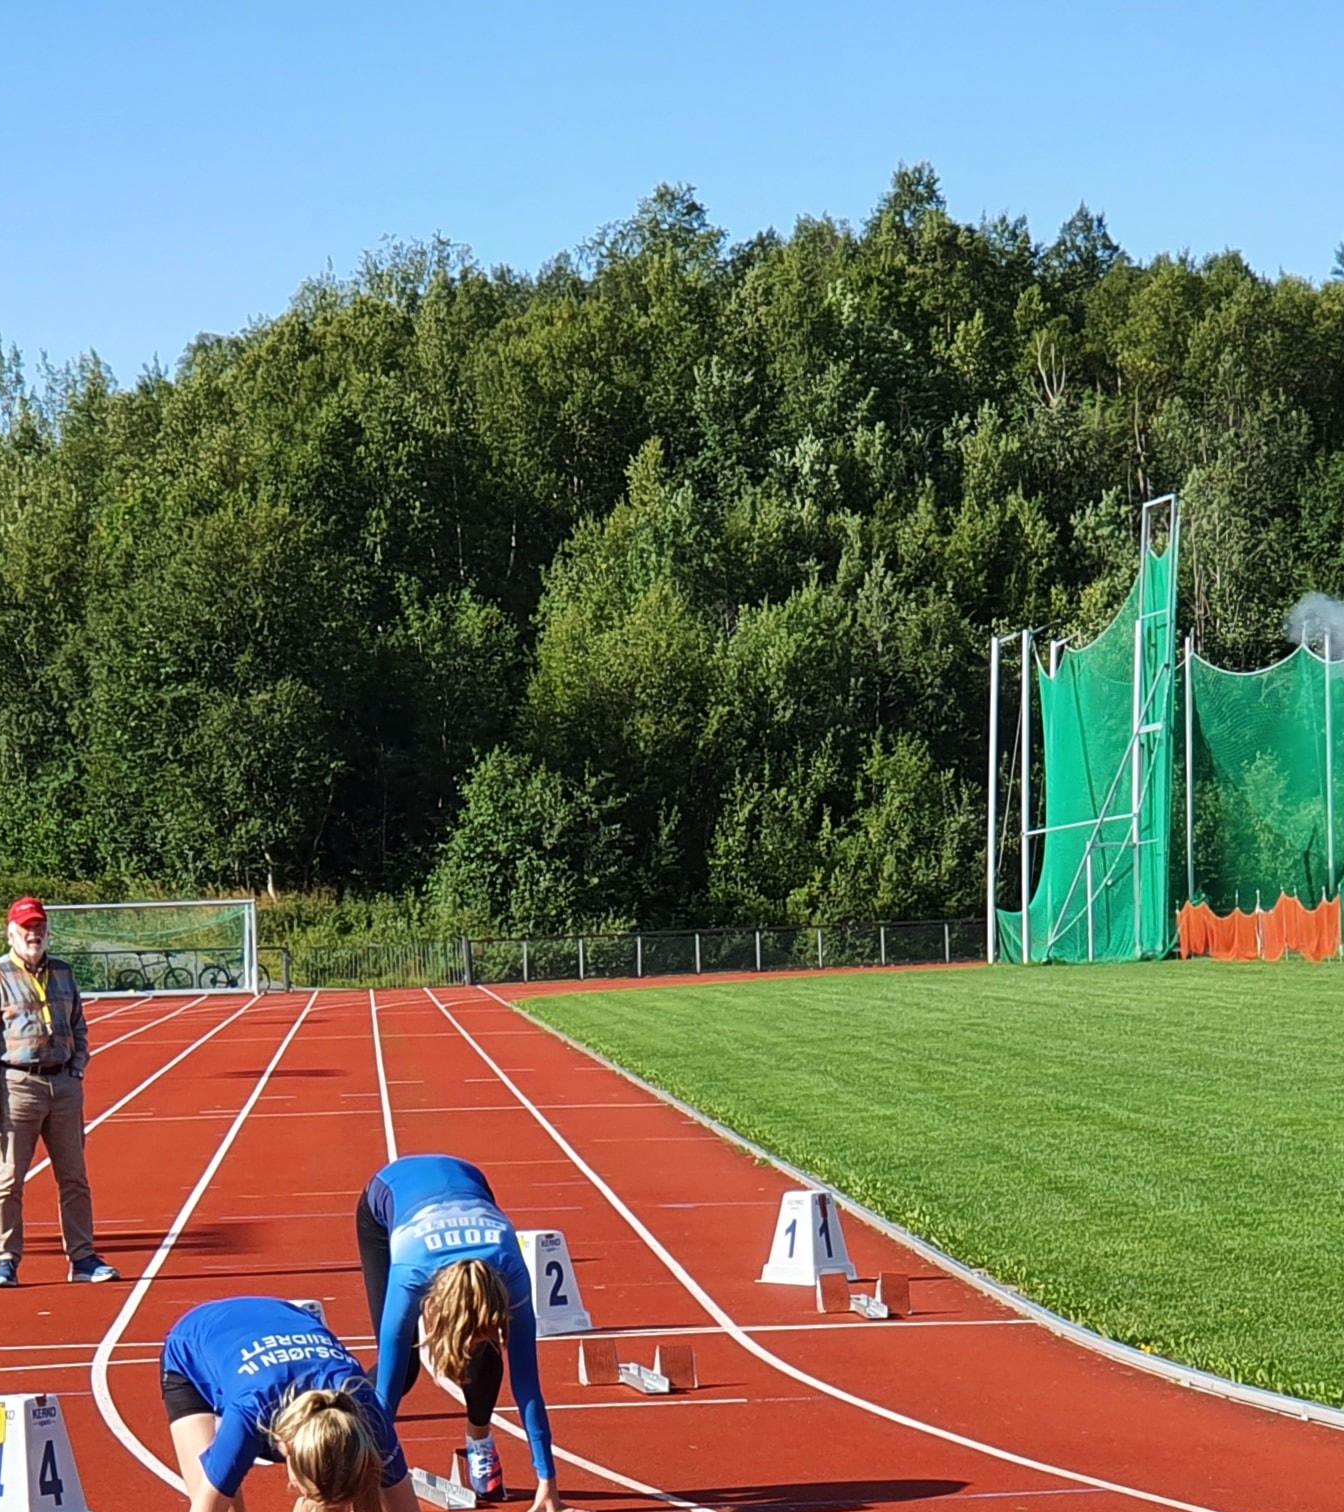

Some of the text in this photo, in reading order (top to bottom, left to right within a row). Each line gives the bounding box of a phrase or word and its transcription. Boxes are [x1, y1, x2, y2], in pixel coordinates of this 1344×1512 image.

[785, 1218, 797, 1258] 1
[819, 1218, 833, 1258] 1
[545, 1260, 568, 1307] 2
[237, 1361, 260, 1375] IL
[39, 1439, 64, 1506] 4
